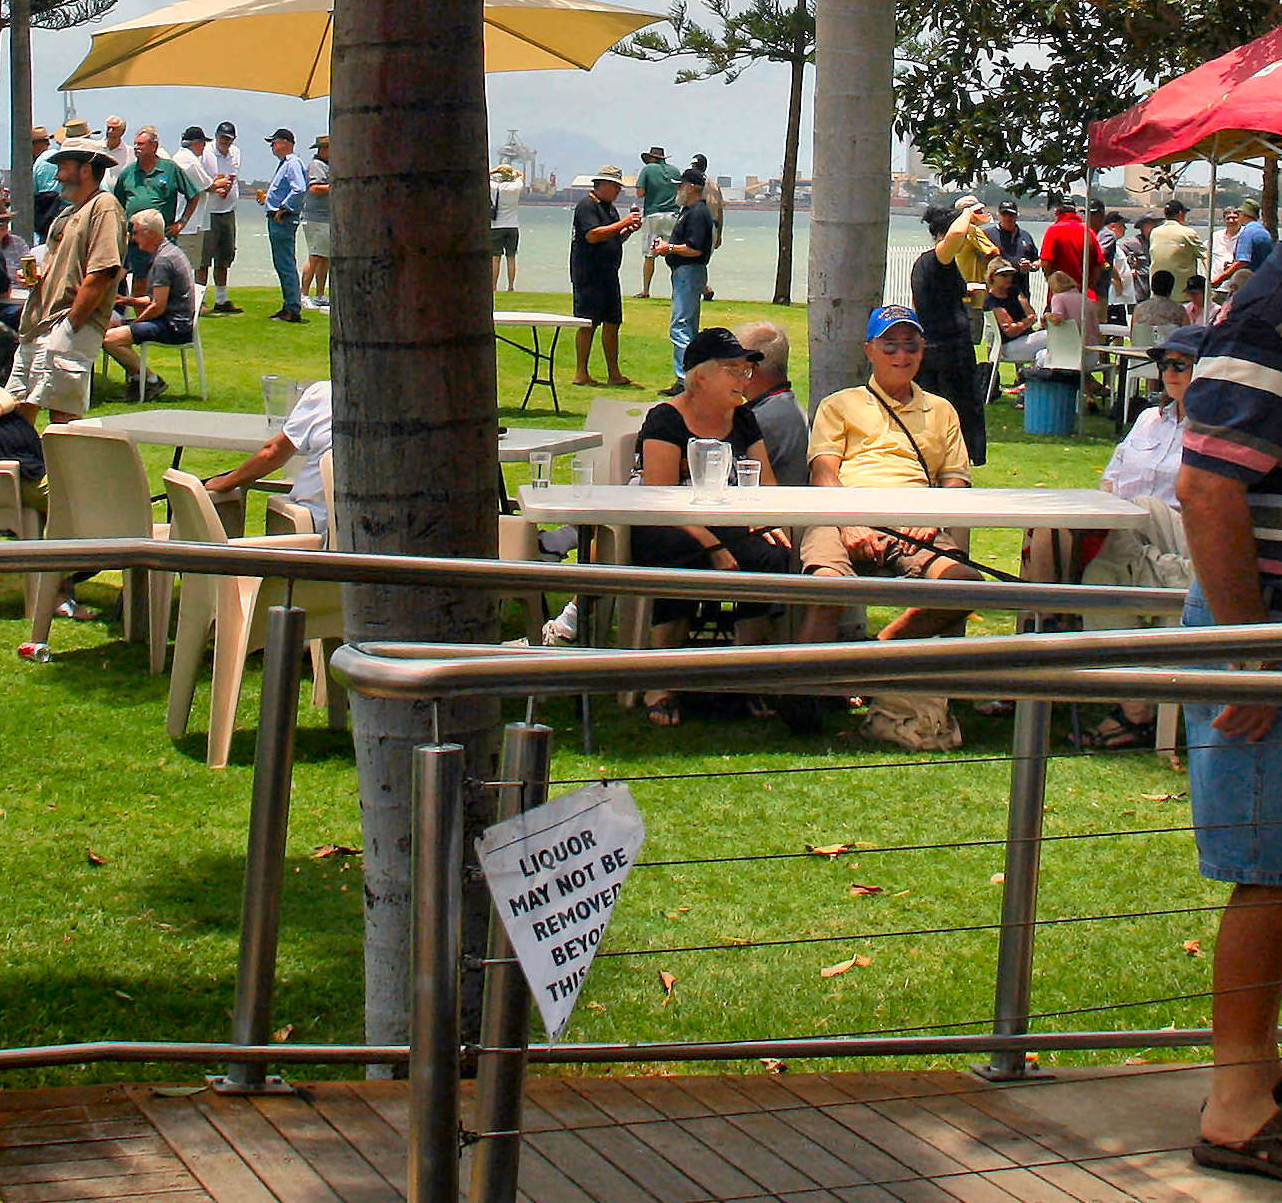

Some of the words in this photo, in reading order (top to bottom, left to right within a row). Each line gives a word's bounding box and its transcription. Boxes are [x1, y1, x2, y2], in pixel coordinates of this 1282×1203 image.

[519, 829, 597, 877] LIQUOR
[509, 883, 551, 917] MAY
[556, 863, 596, 896] NOT
[601, 848, 629, 875] BE
[551, 923, 605, 967] BEYO
